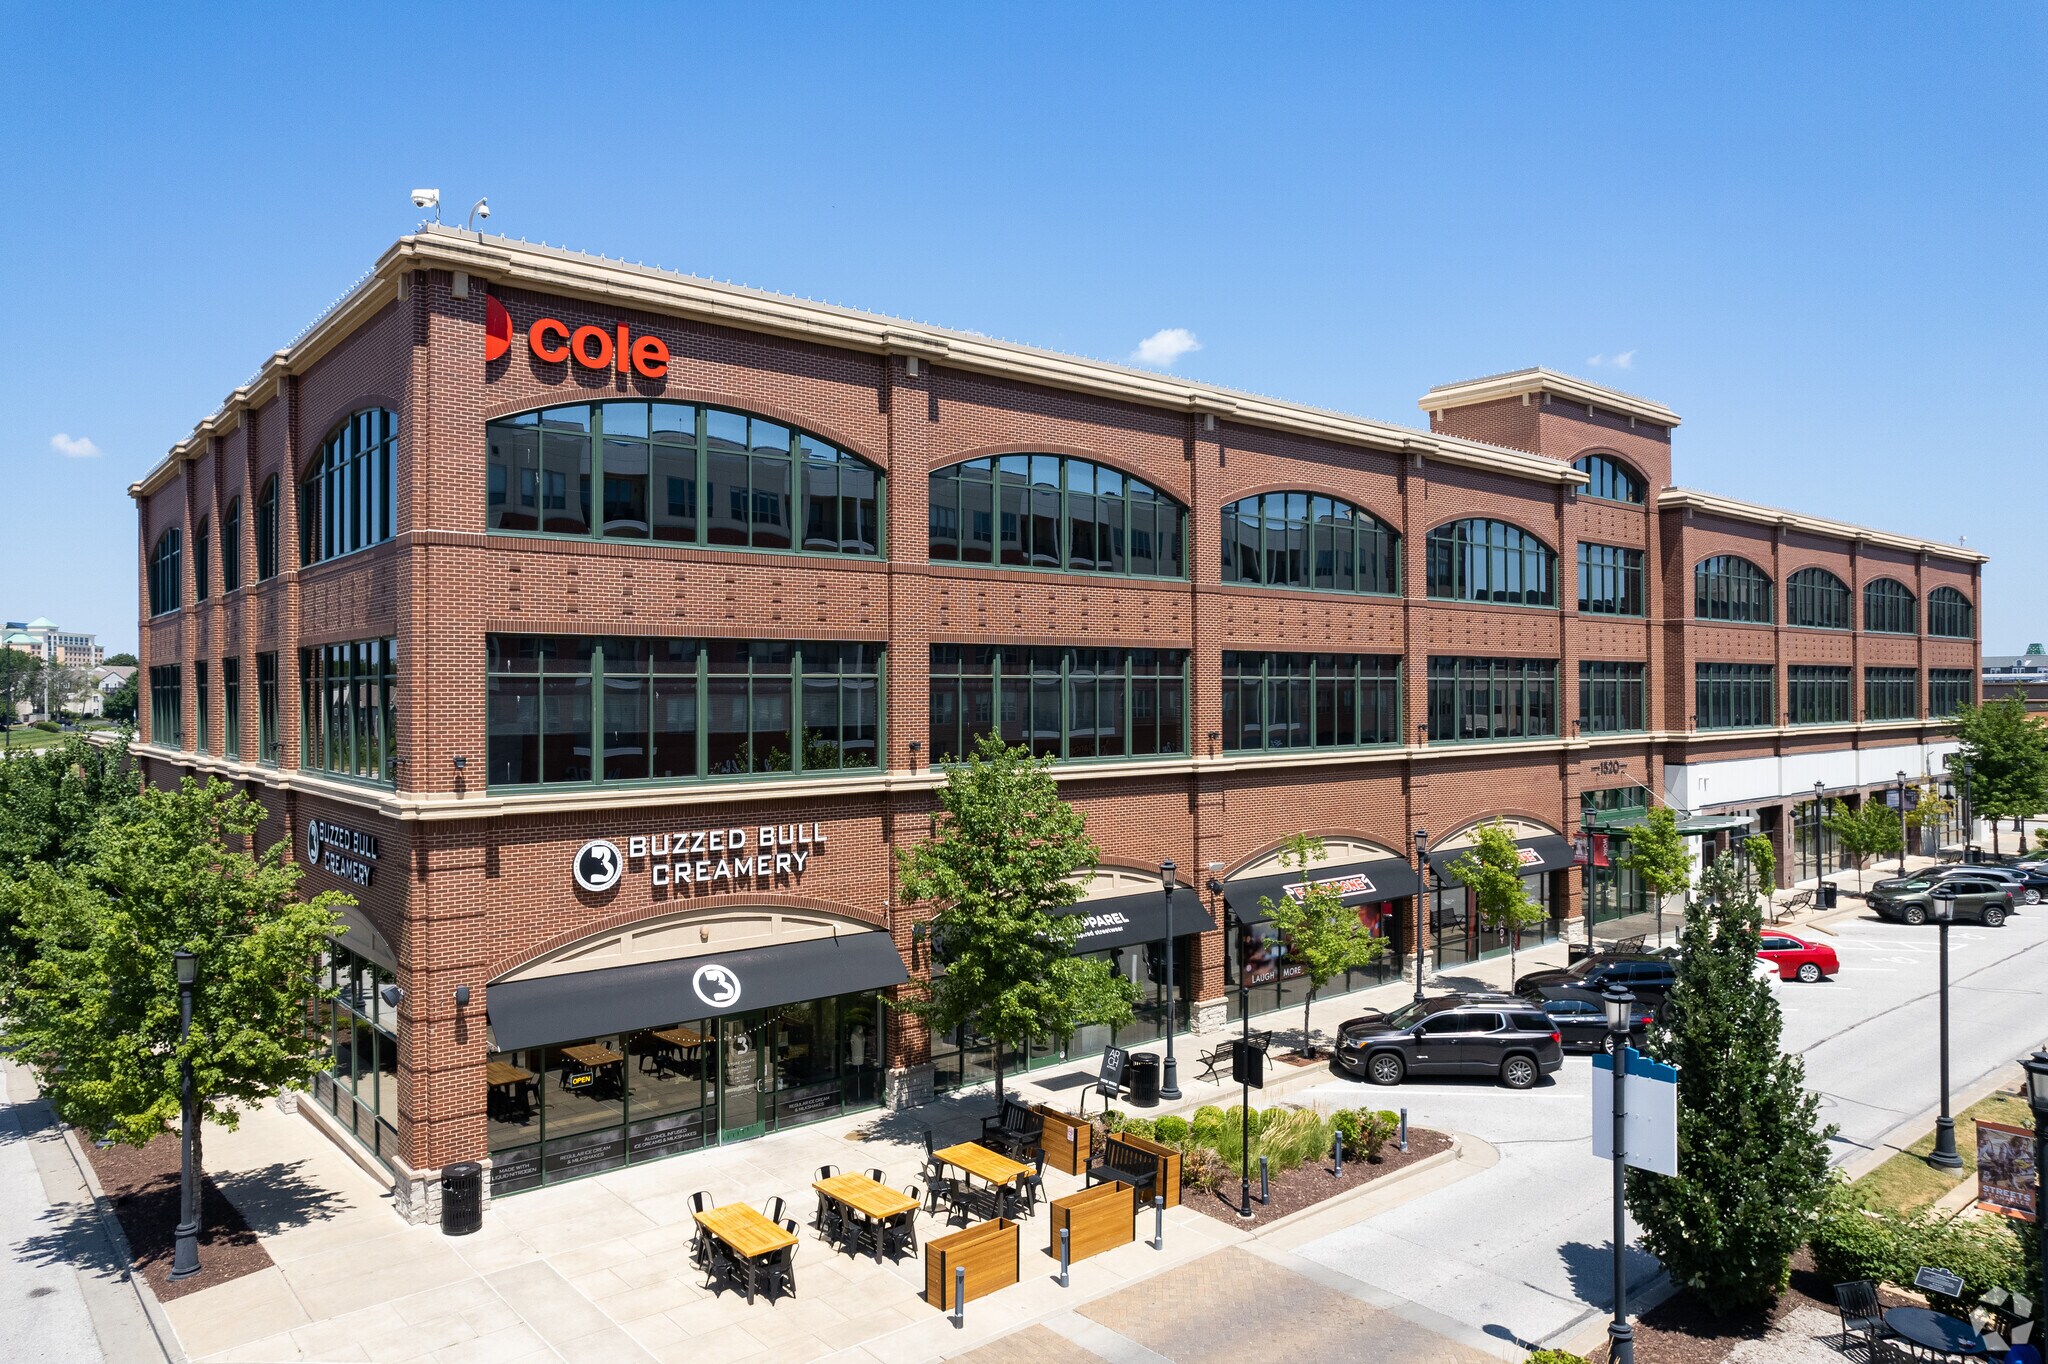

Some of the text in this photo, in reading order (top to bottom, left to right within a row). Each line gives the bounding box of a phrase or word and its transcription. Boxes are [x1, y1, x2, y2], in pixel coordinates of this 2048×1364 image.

[529, 318, 670, 378] cole
[319, 822, 377, 860] BUZZED BULL
[629, 822, 828, 858] BUZZED BULL
[325, 851, 370, 887] CREAMERY
[652, 851, 809, 886] CREAMERY
[1251, 971, 1275, 984] LAUGH
[572, 1075, 591, 1085] OPEN
[644, 1128, 688, 1141] ALCOHOL INFUSED
[560, 1150, 584, 1160] REGULAR
[571, 1152, 605, 1163] MILKSHAKES
[491, 1167, 537, 1181] LIQUID NITROGEN
[1982, 1184, 2031, 1202] STREETS
